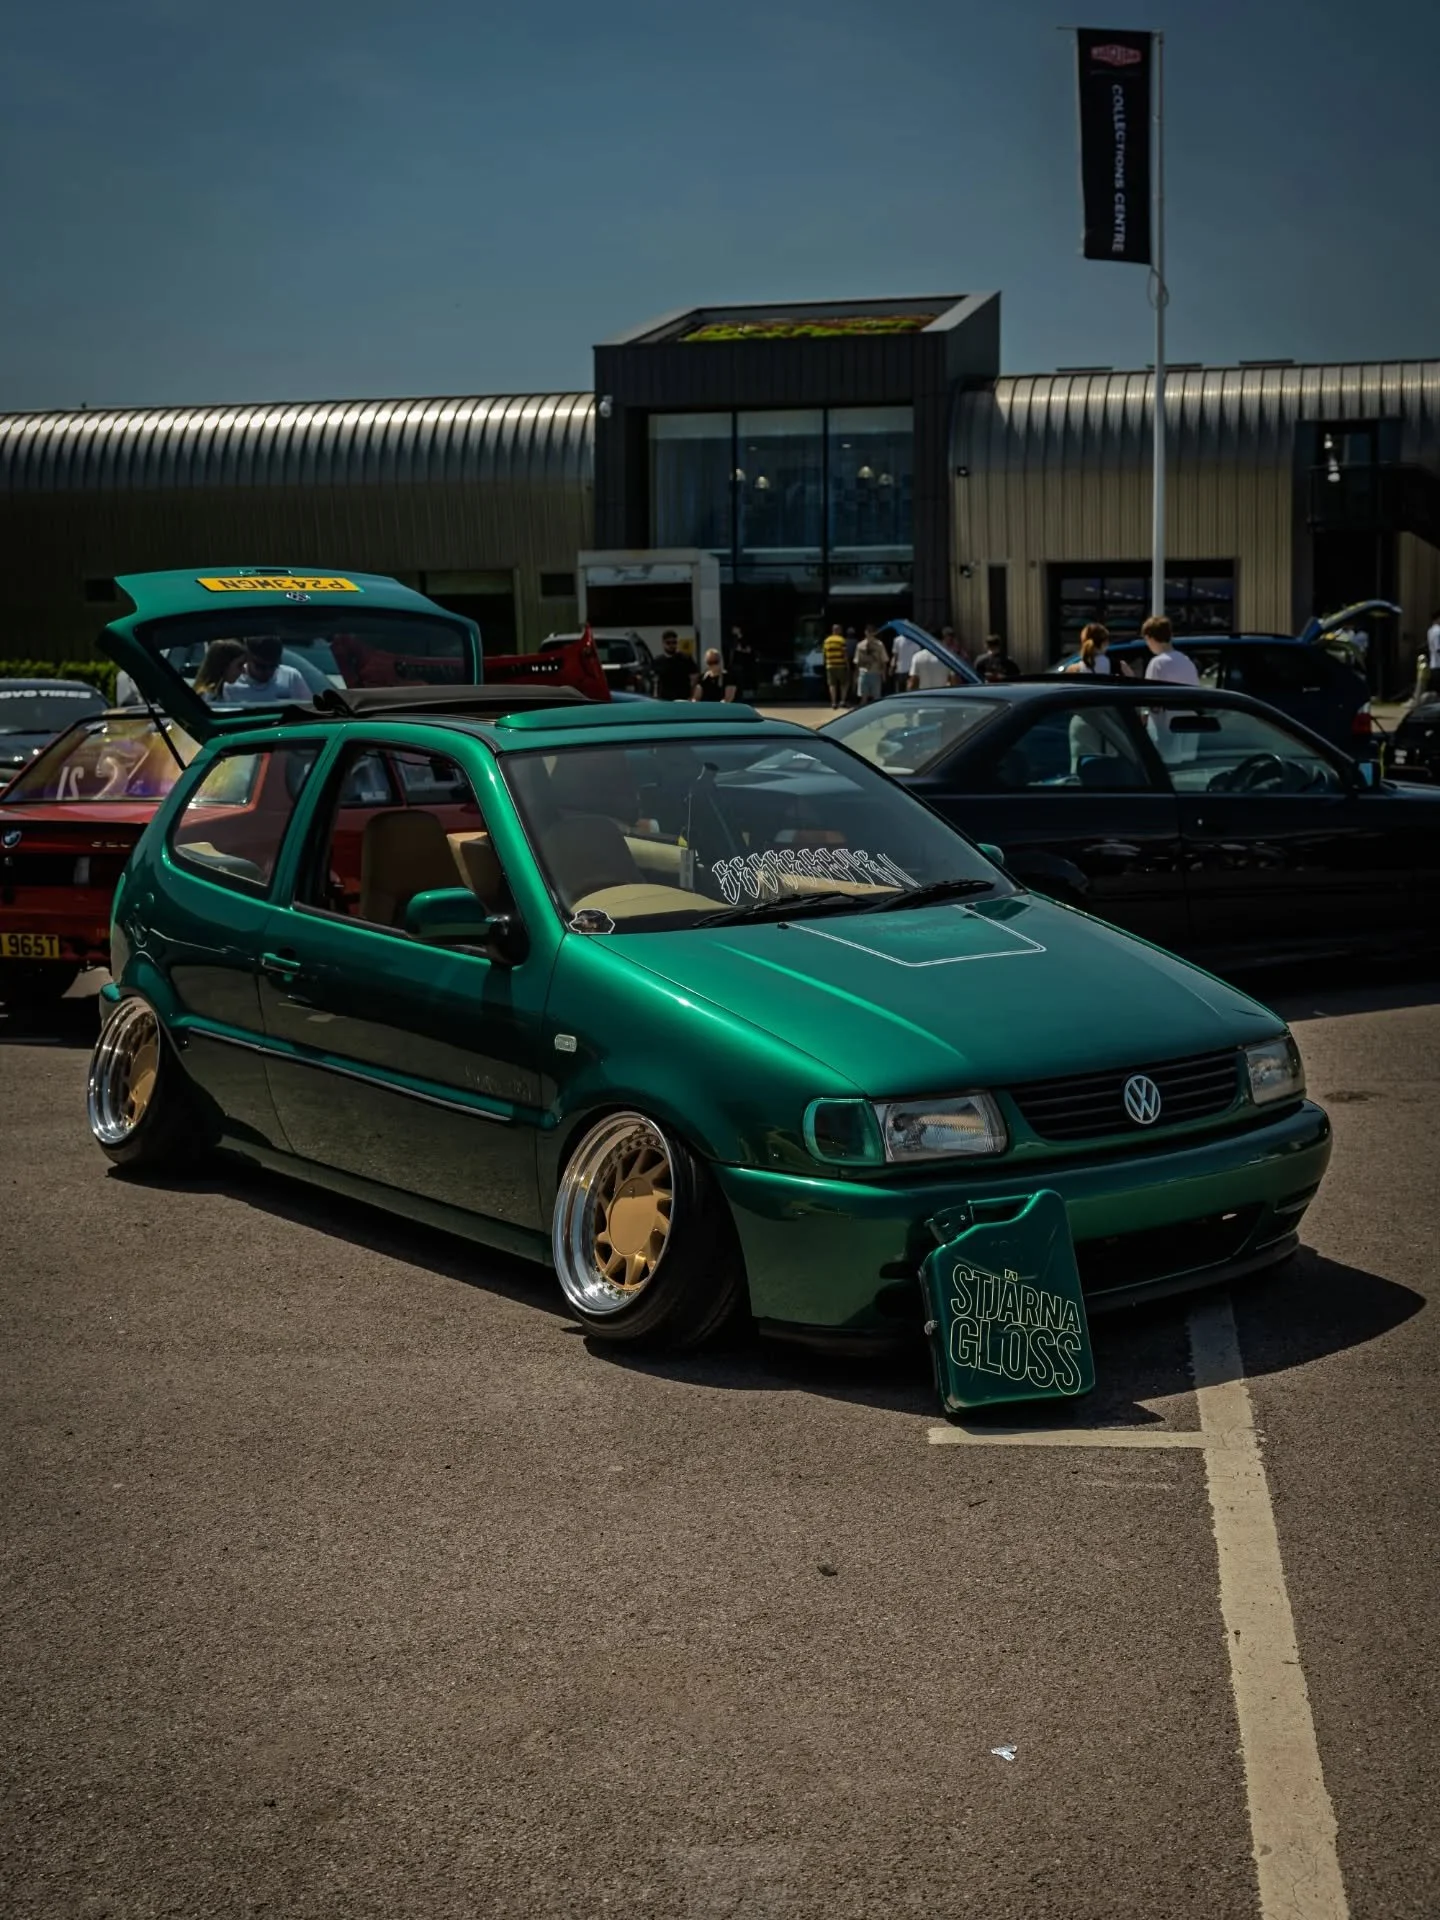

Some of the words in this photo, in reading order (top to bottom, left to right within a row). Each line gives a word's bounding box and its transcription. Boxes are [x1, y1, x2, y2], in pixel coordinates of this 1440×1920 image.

[1112, 84, 1126, 188] COLLECTIONS
[1112, 193, 1126, 252] CENTRE
[8, 935, 56, 957] 965T
[950, 1316, 1082, 1396] GLOSS
